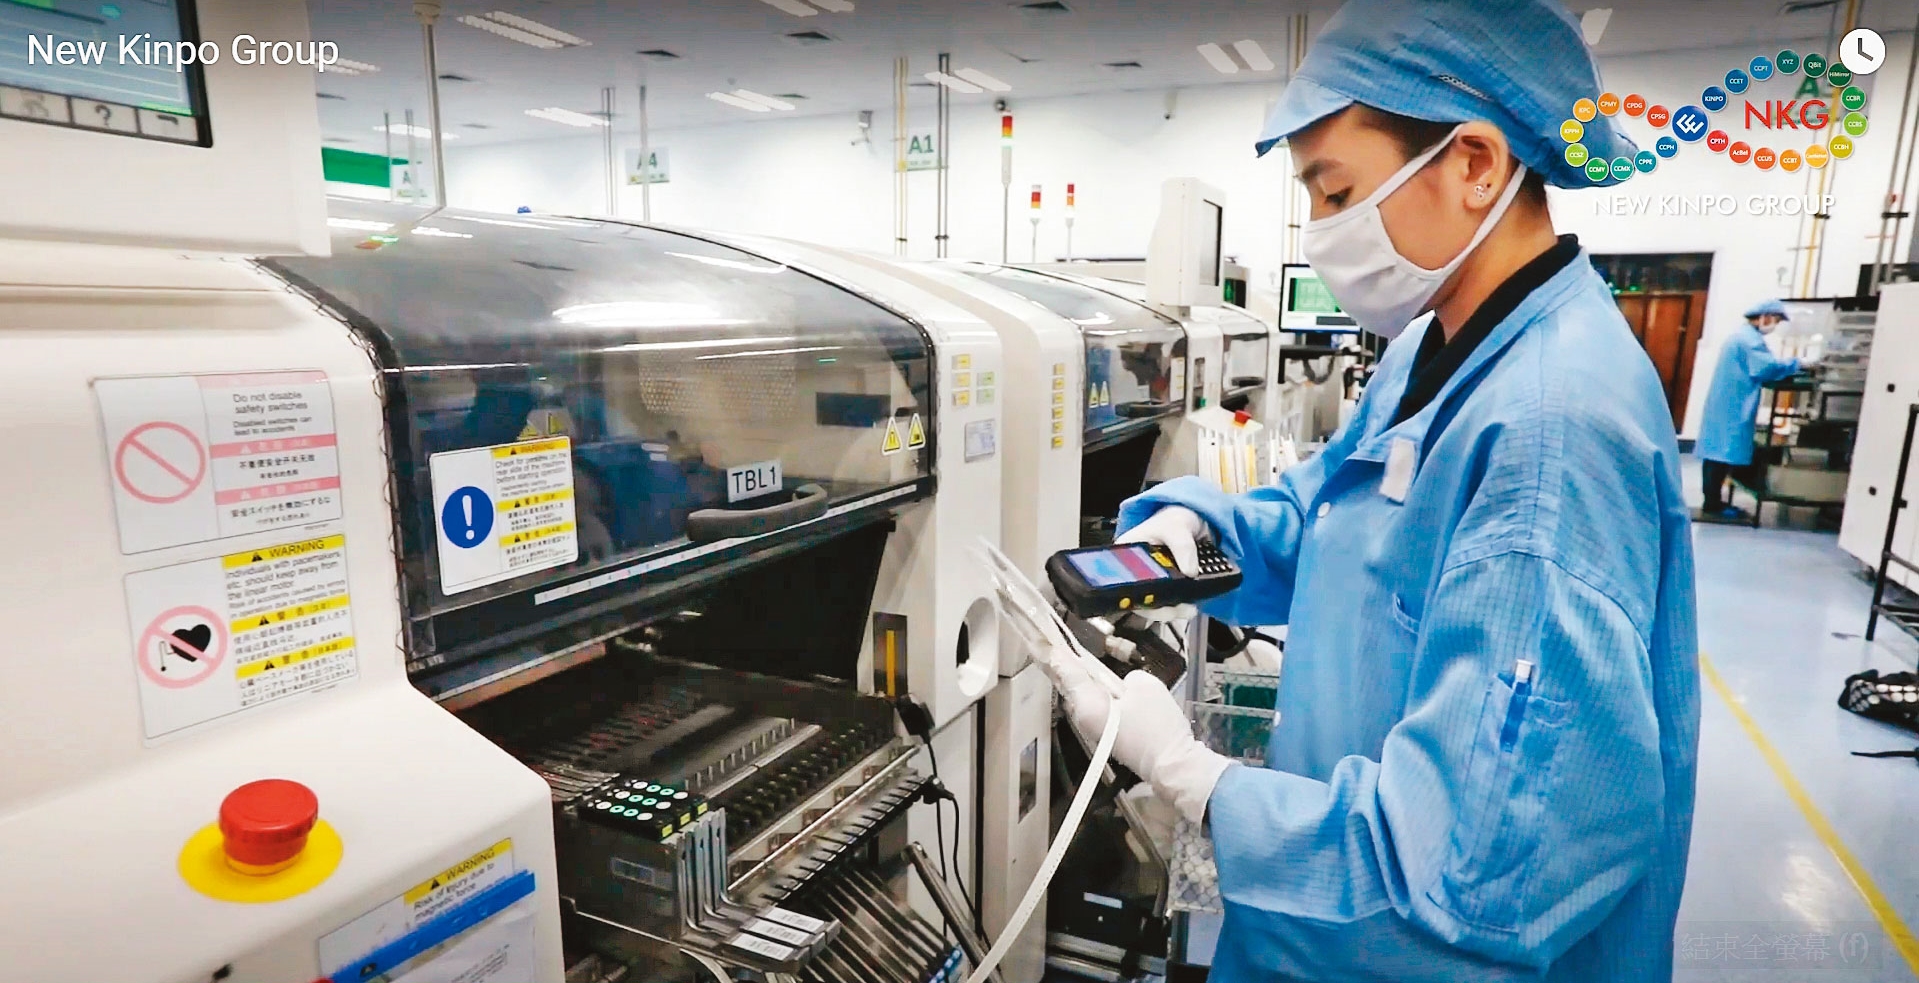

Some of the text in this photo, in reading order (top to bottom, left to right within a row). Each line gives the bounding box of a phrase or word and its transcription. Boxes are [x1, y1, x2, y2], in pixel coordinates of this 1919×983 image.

[908, 134, 935, 155] A1
[233, 392, 303, 402] Do not disable
[235, 402, 308, 414] safety switches
[732, 465, 775, 494] TBL1
[269, 540, 325, 557] WARNING
[447, 848, 495, 880] WARNING
